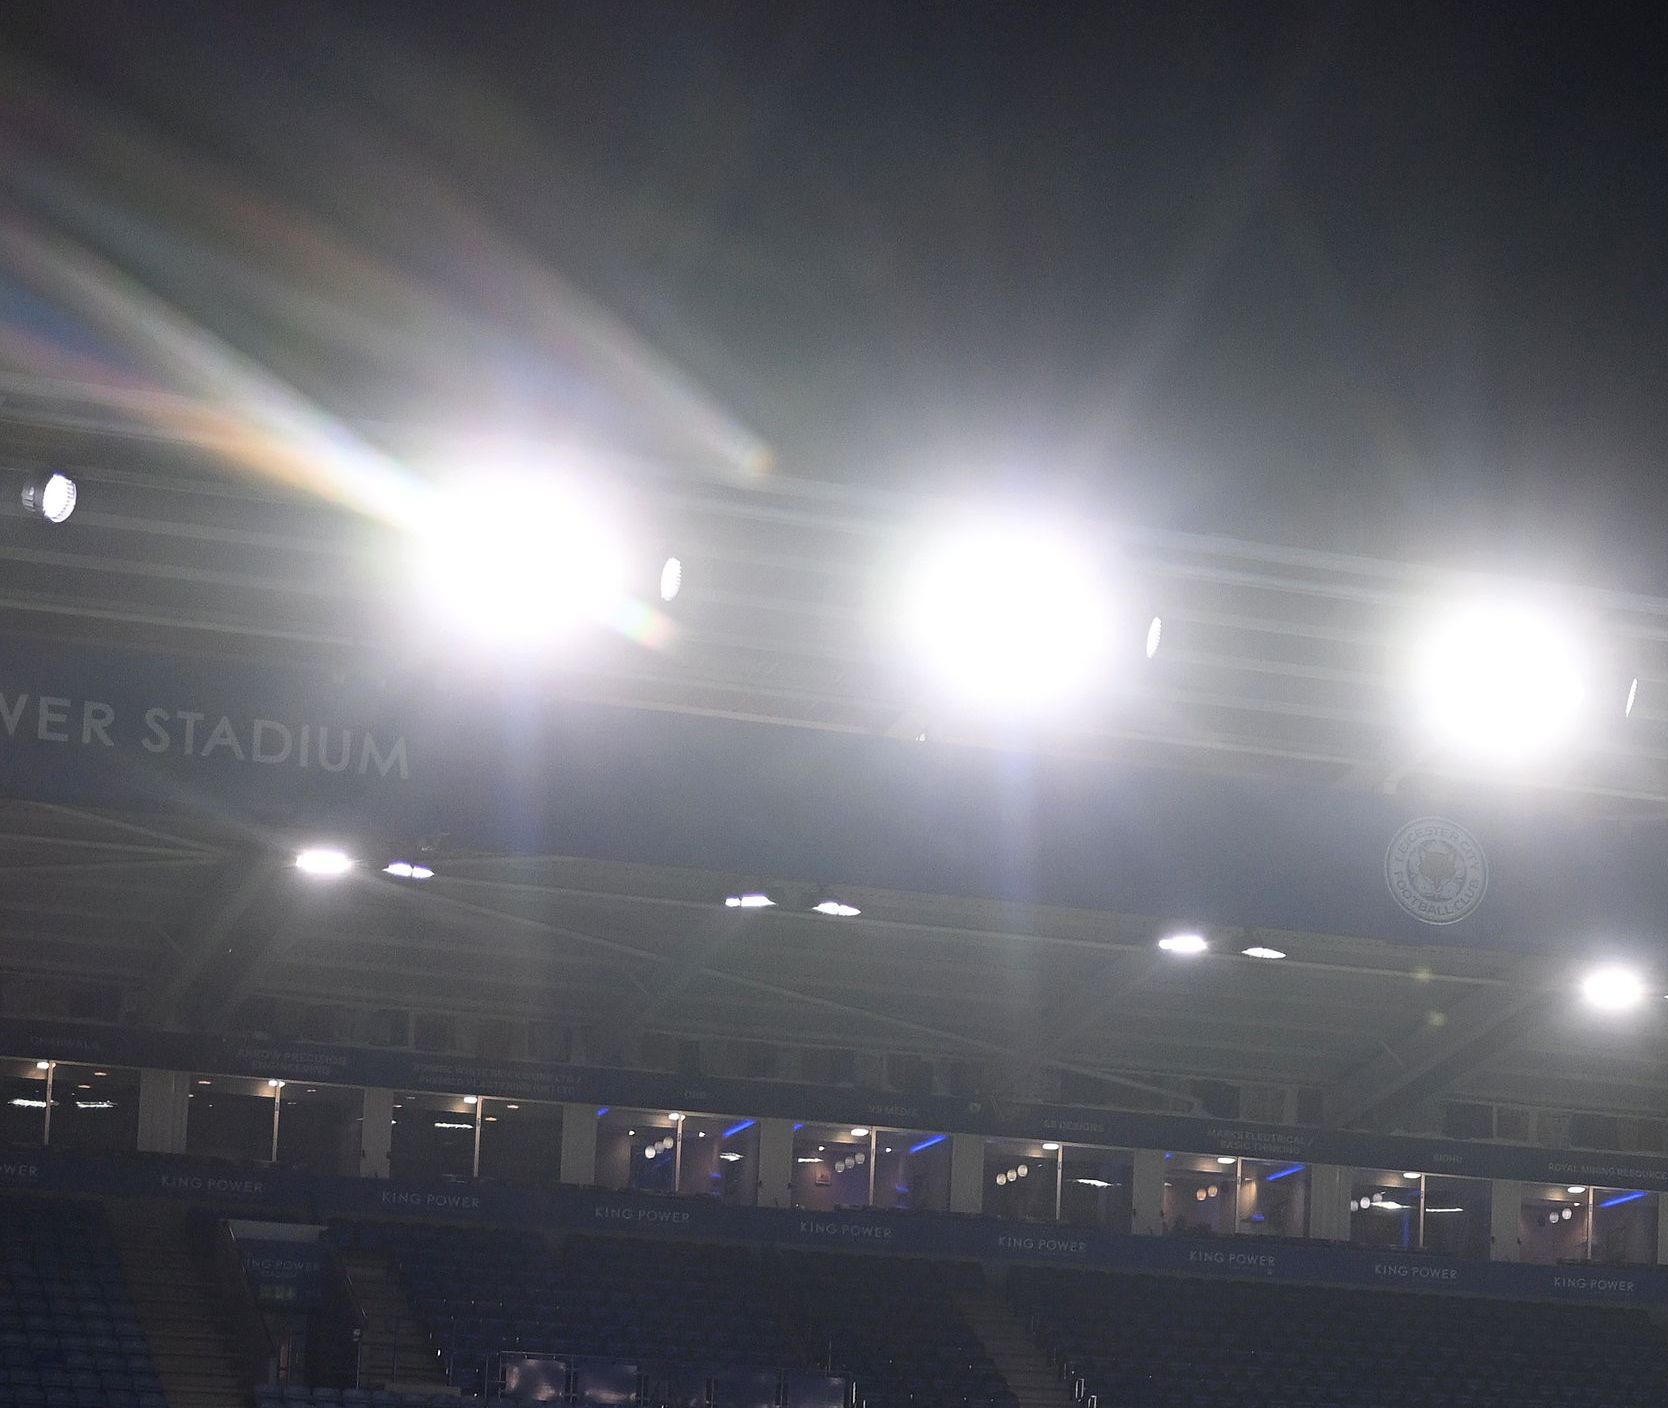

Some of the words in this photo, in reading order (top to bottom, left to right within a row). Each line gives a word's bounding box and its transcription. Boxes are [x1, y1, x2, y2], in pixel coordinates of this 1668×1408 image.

[141, 706, 409, 780] STADIUM
[208, 1178, 264, 1193] POWER
[382, 1191, 422, 1205] KING
[427, 1194, 480, 1209] POWER
[595, 1207, 634, 1220] KING
[638, 1210, 690, 1224] POWER
[800, 1221, 838, 1234] KING
[842, 1223, 893, 1238] POWER
[998, 1236, 1034, 1250] KING
[1038, 1239, 1087, 1252] POWER
[1190, 1250, 1224, 1264] KING
[1228, 1253, 1276, 1267] POWER
[1375, 1263, 1409, 1277] KING
[1412, 1266, 1458, 1280] POWER
[1554, 1276, 1587, 1290] KING
[1590, 1279, 1634, 1292] POWER
